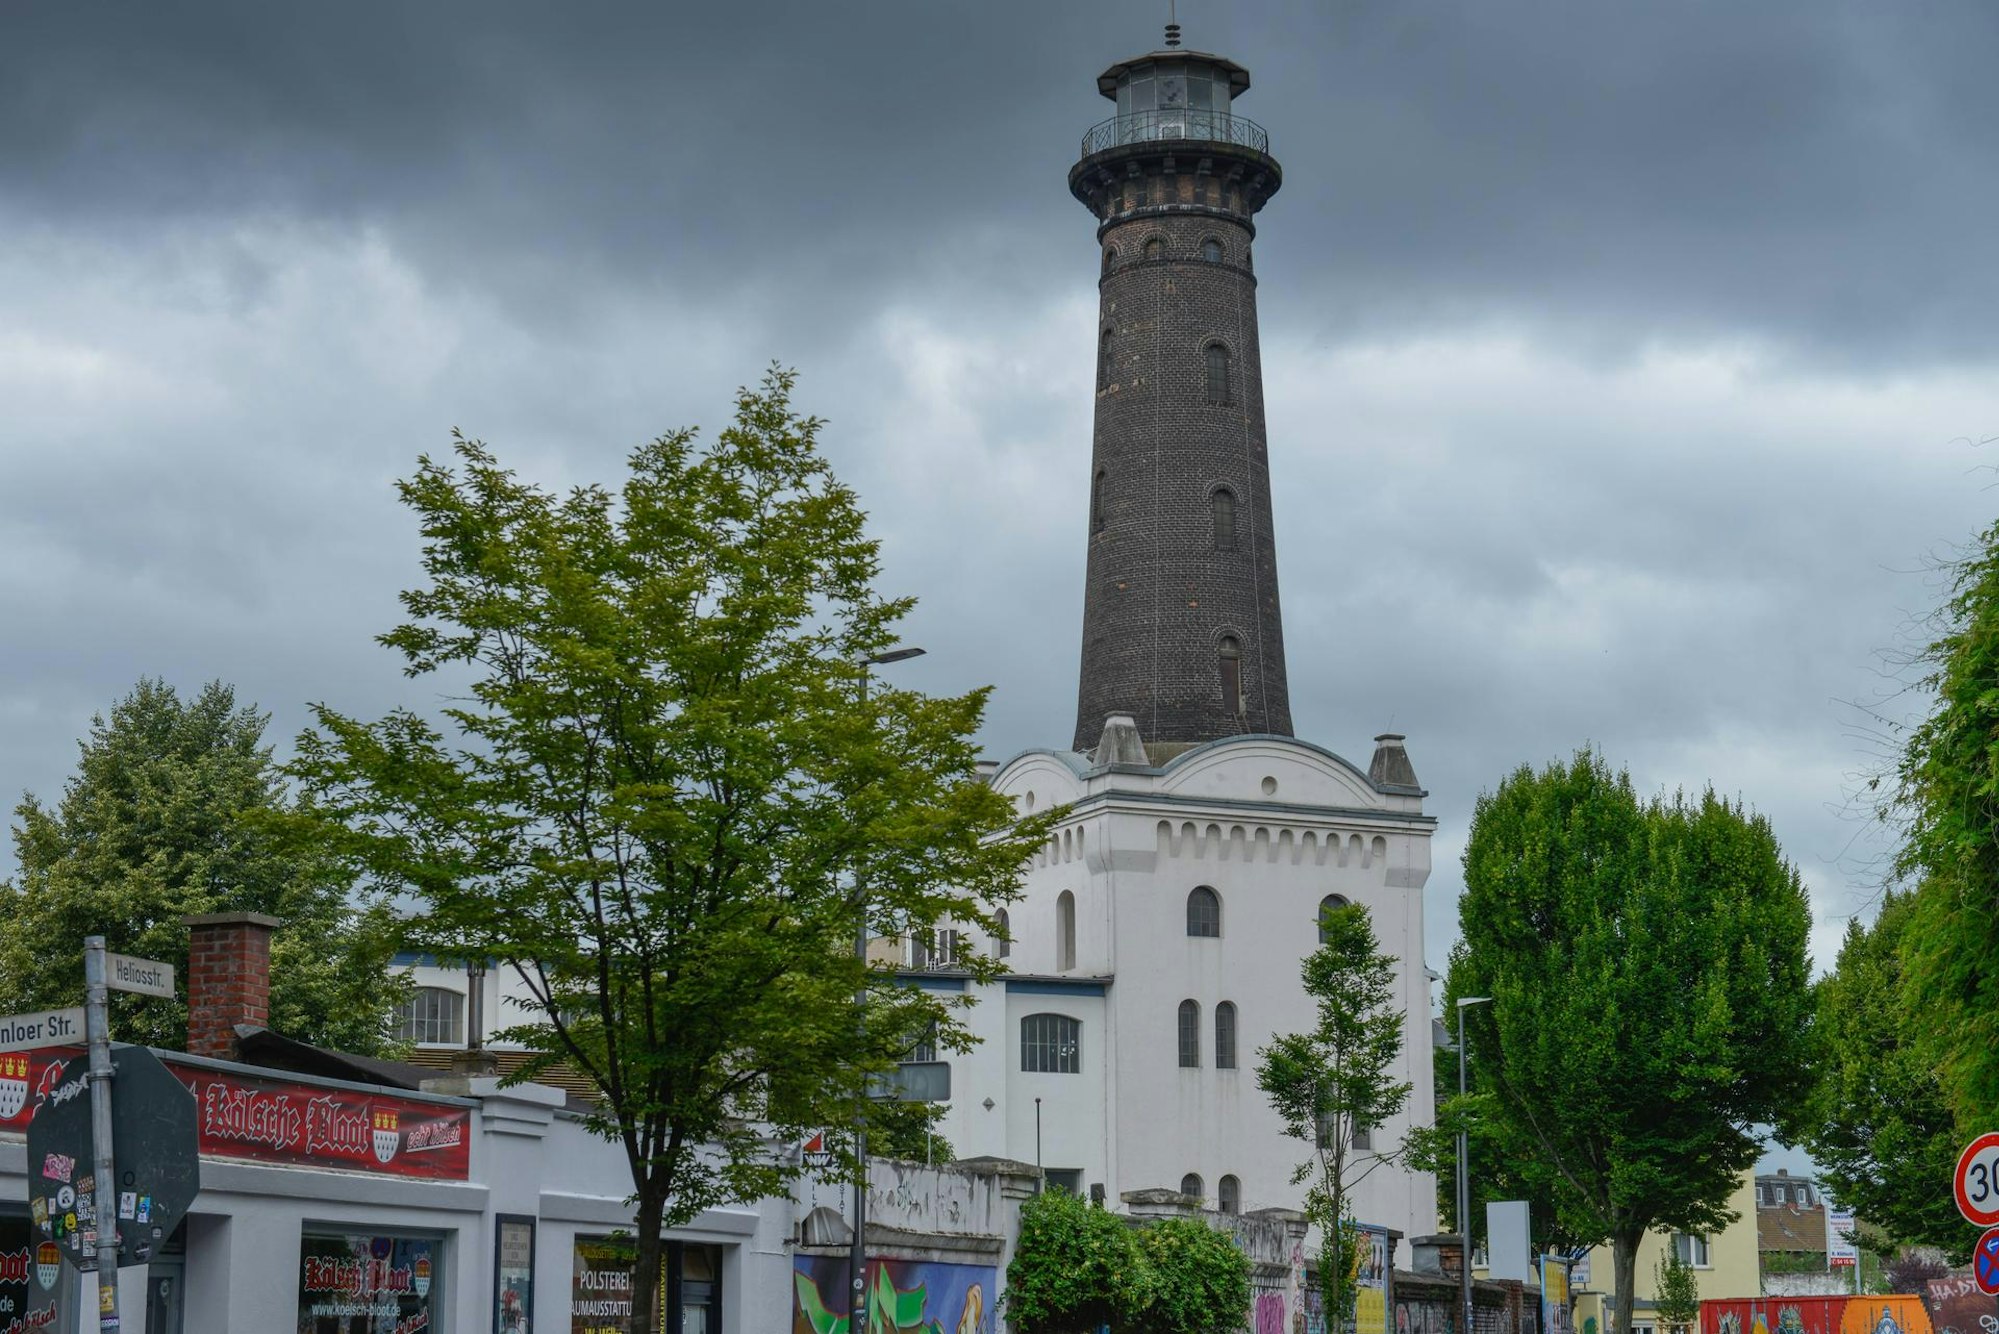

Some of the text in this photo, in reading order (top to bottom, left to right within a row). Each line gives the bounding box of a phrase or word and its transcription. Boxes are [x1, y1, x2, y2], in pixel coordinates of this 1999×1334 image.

[116, 959, 165, 988] Heliosstr.
[0, 1016, 76, 1044] nloer Str.
[205, 1083, 370, 1154] Kölsche Bloot
[580, 1270, 630, 1290] POLSTEREI
[311, 1302, 401, 1316] www.koelsch-bloot.de
